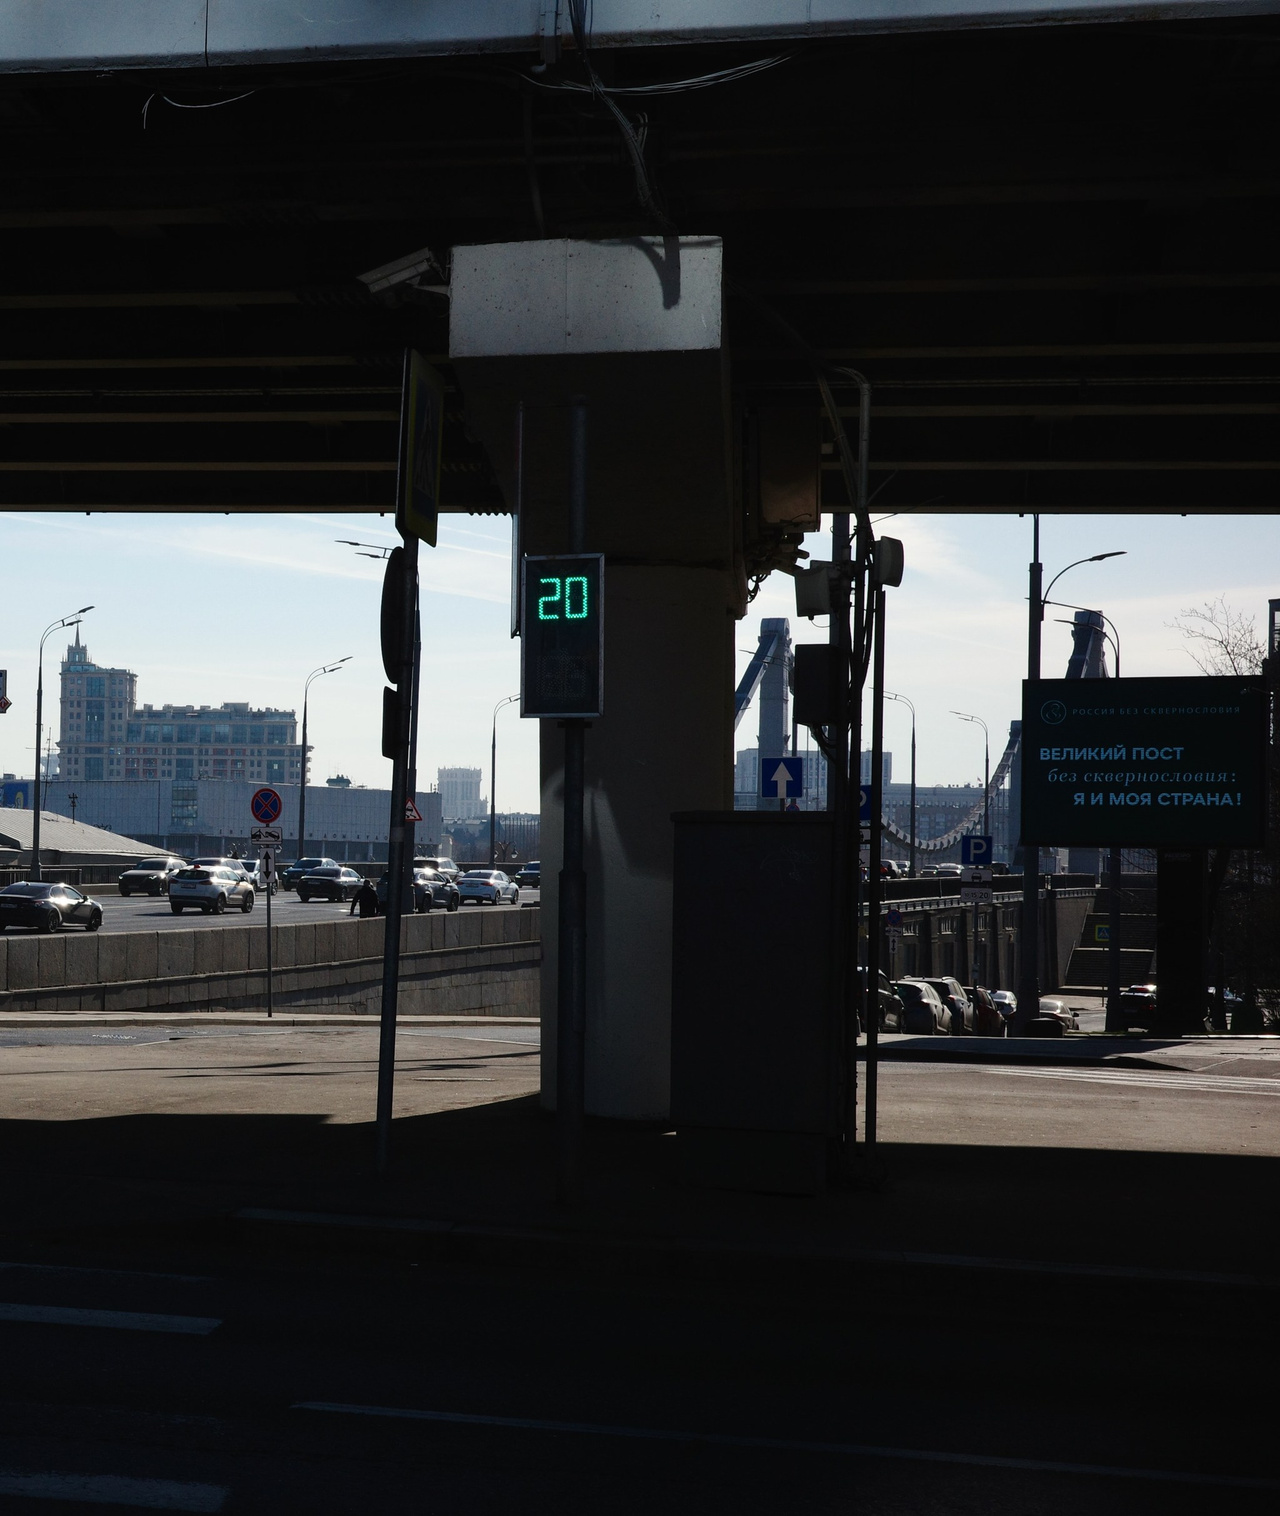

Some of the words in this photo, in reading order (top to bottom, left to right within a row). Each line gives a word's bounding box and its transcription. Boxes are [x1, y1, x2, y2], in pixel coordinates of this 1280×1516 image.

[538, 576, 588, 620] 20
[1072, 708, 1115, 716] РОССИЯ
[1143, 706, 1240, 715] СКВЕРНОСЛОВИЯ
[1039, 744, 1126, 761] ВЕЛИКИЙ
[1132, 746, 1184, 761] ПОСТ
[1048, 768, 1077, 783] без
[1083, 772, 1237, 786] сквернословия:
[1073, 792, 1085, 806] Я
[1090, 792, 1104, 806] И
[1109, 792, 1152, 806] МОЯ
[1157, 792, 1241, 806] СТРАНА!
[969, 838, 987, 862] P
[979, 891, 989, 899] 20
